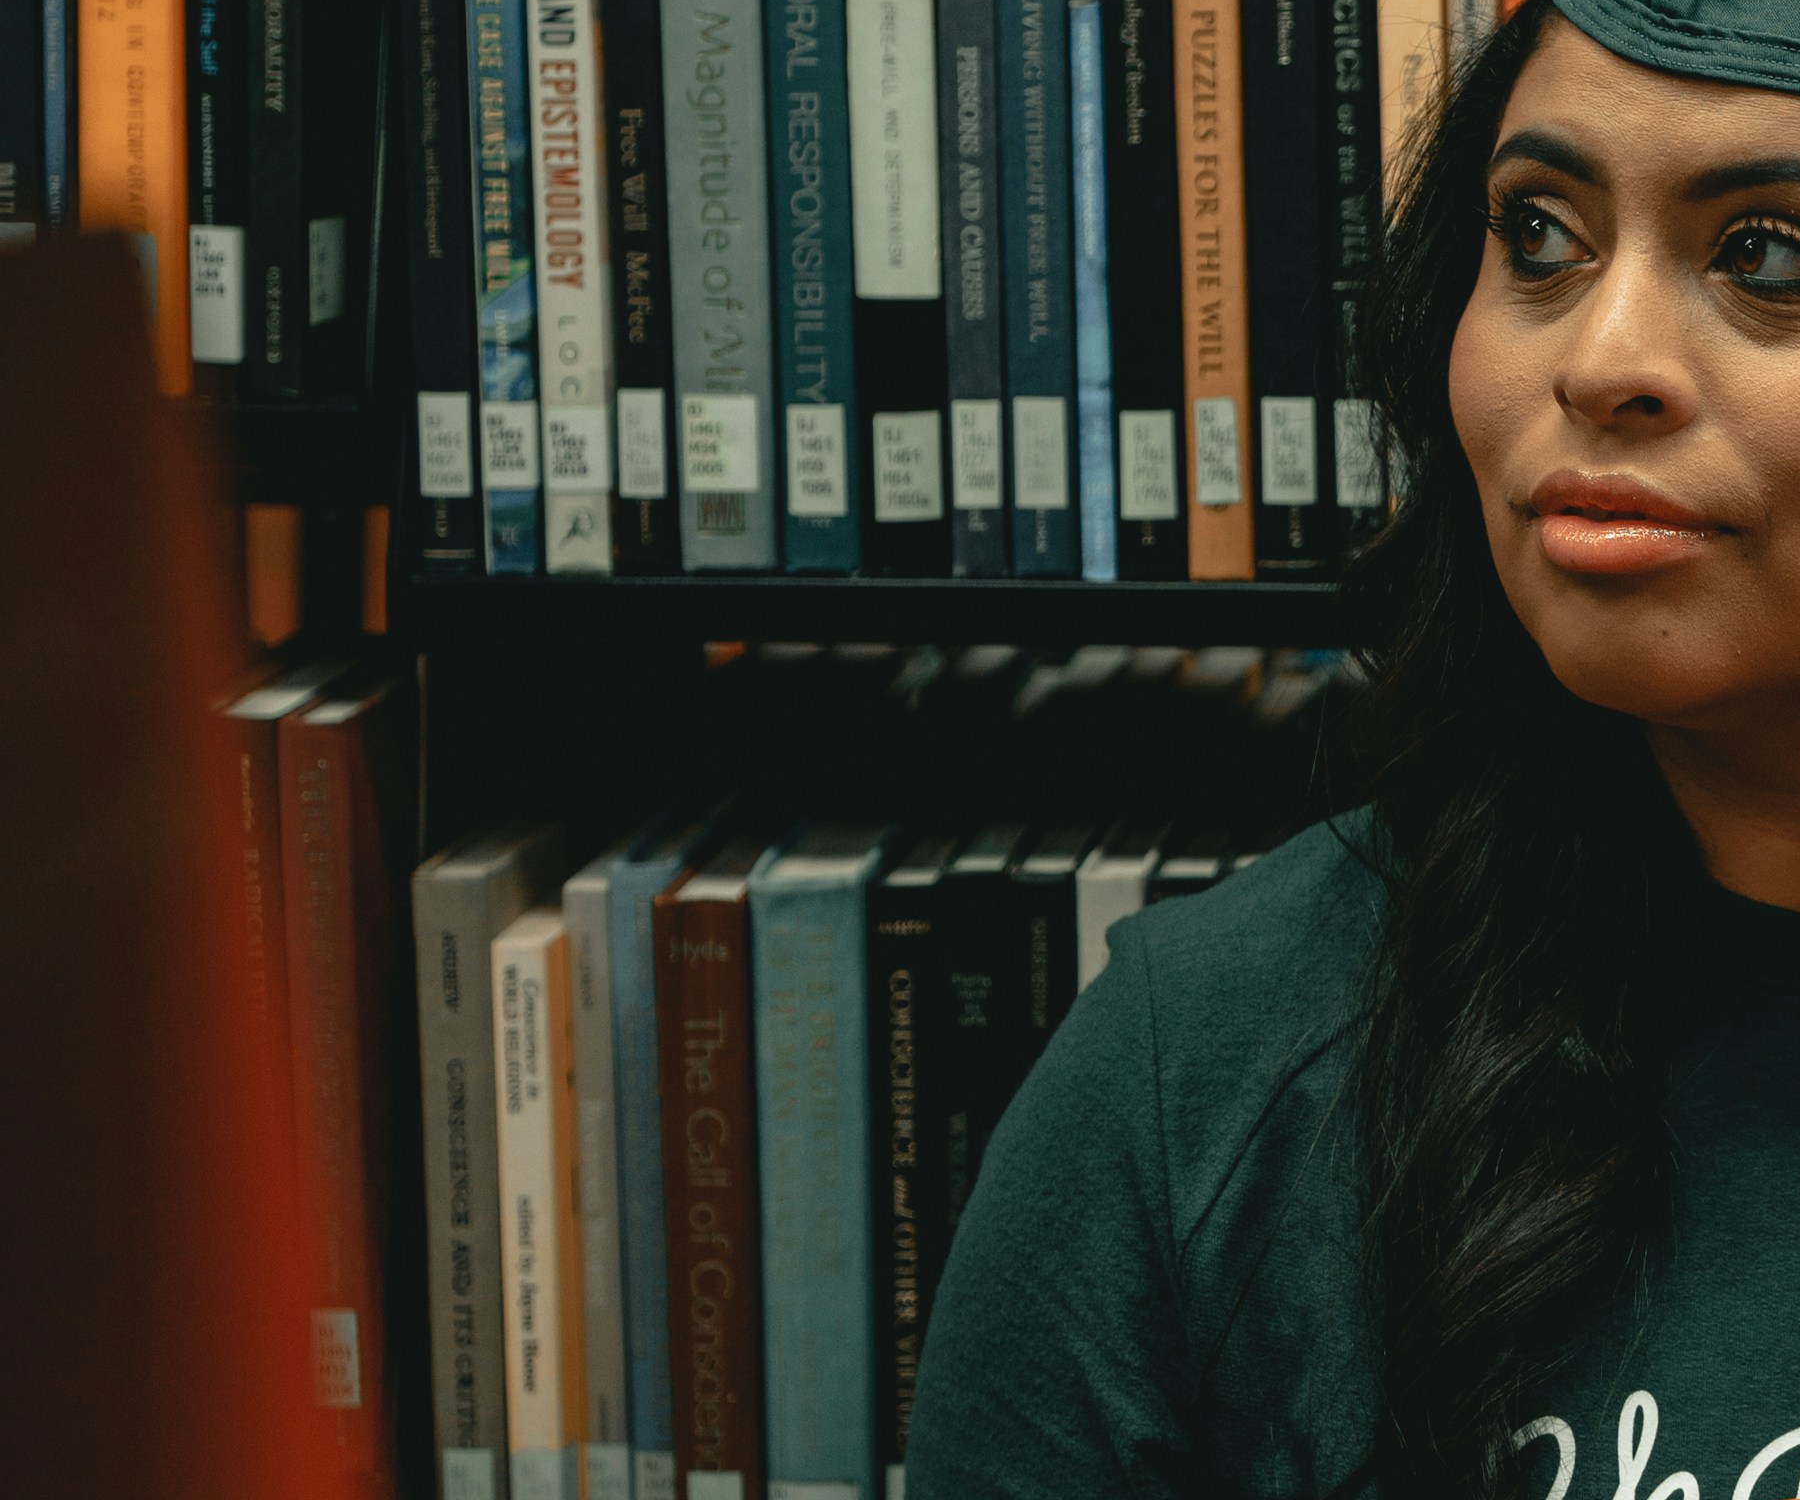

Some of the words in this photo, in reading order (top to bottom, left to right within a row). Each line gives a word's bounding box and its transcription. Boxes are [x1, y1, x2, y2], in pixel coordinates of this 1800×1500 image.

[199, 39, 221, 78] Self
[480, 13, 503, 68] CASE
[955, 45, 984, 156] PERSONS
[1189, 9, 1221, 144] PUZZLES
[482, 77, 506, 175] AGAINST
[618, 106, 646, 167] Free
[685, 10, 739, 255] Magnitude
[1022, 85, 1048, 203] WITHOUT
[485, 177, 508, 235] FREE
[539, 60, 587, 291] EPISTEMOLOGY
[622, 171, 650, 232] Will
[958, 162, 985, 219] AND
[1192, 153, 1223, 219] FOR
[785, 90, 827, 404] RESPONSIBILITY
[1026, 212, 1049, 272] FREE
[1195, 229, 1223, 289] THE
[1340, 194, 1370, 268] WILL
[487, 241, 510, 293] WILL
[625, 251, 652, 343] McFee
[700, 264, 745, 312] of
[959, 225, 987, 321] CAUSES
[1028, 278, 1050, 343] WILL
[1197, 295, 1227, 380] WILL
[669, 937, 732, 966] Hyde
[502, 965, 520, 1020] WORLD
[503, 1026, 524, 1116] RELIGIONS
[682, 1008, 728, 1095] The
[889, 969, 917, 1170] CONSCIENCE
[446, 1058, 473, 1227] CONSCIENCE
[687, 1107, 734, 1190] Call
[516, 1194, 539, 1248] edited
[689, 1201, 735, 1252] of
[450, 1239, 473, 1297] AND
[892, 1222, 919, 1325] OTHER
[452, 1303, 475, 1346] ITS
[516, 1277, 542, 1333] Jayne
[521, 1337, 543, 1393] Hoose
